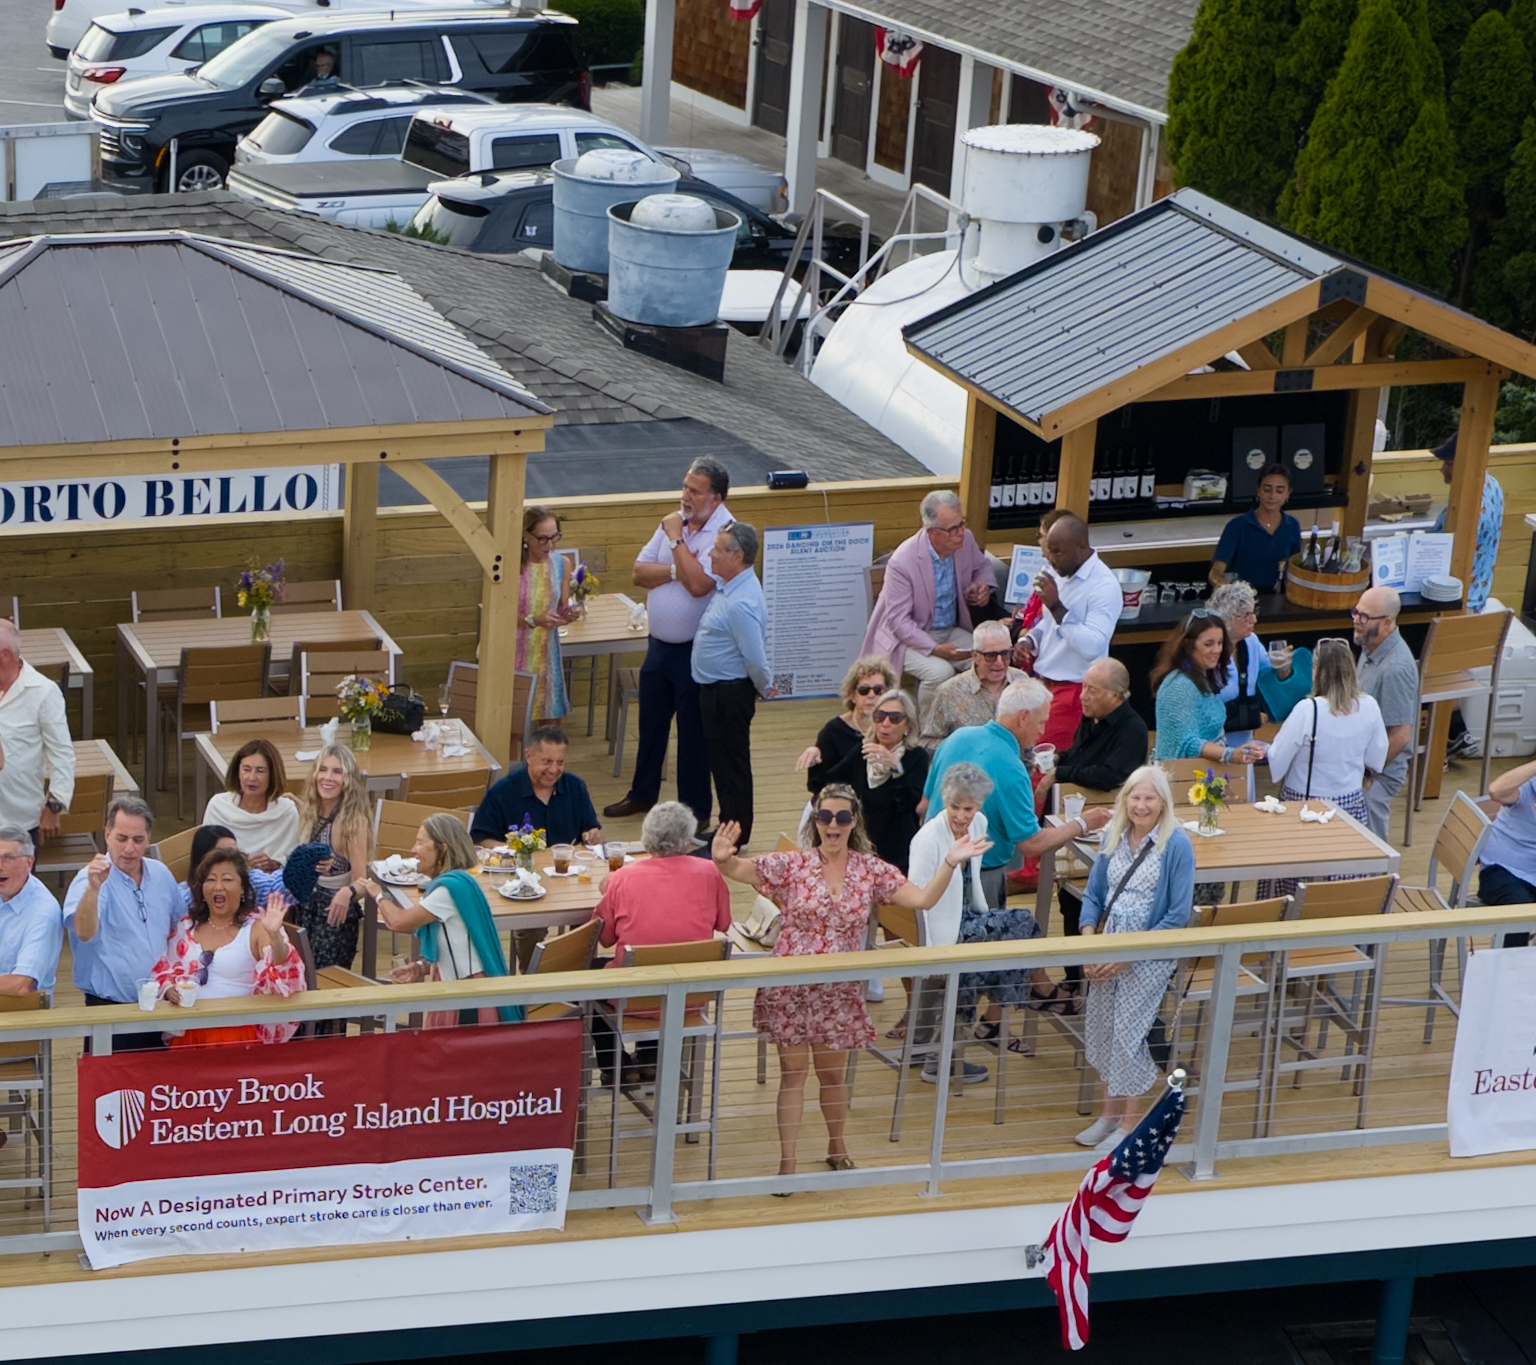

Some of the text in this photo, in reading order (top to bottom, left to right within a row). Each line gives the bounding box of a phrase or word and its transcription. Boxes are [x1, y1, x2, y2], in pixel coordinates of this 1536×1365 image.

[142, 473, 318, 517] BELLO
[151, 1074, 322, 1111] Stony Brook
[151, 1088, 560, 1143] Eastern Long Island Hospital
[94, 1200, 492, 1241] When every second counts, expert stroke care is closer than ever.
[95, 1176, 486, 1222] Now A Designated Primary Stroke Center.
